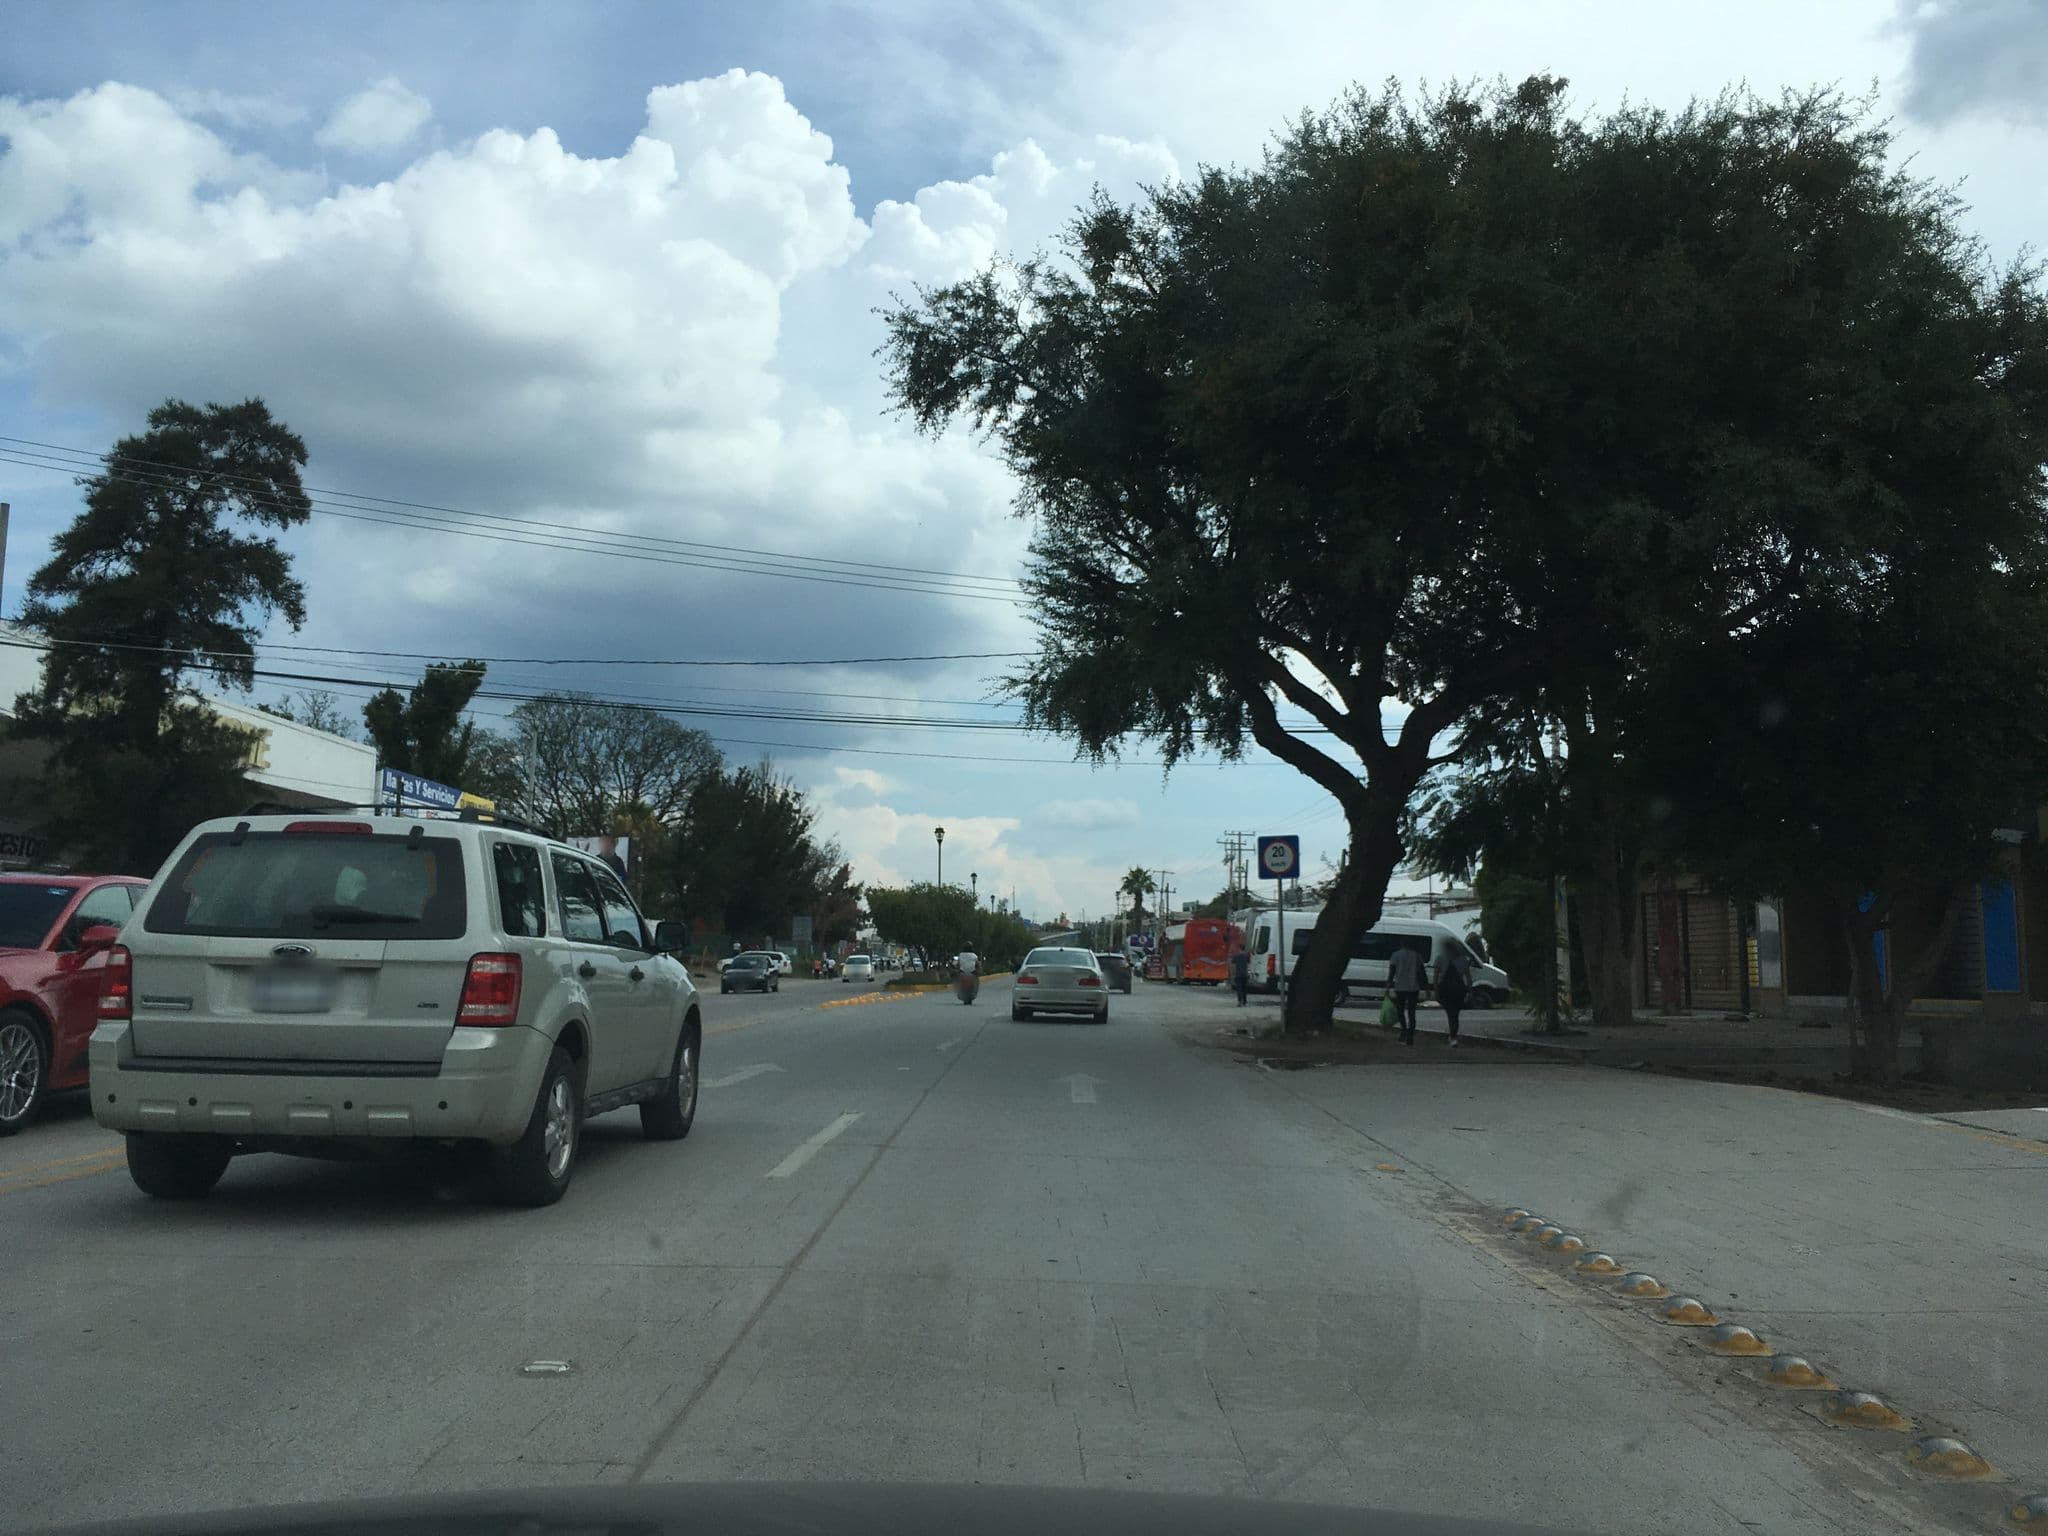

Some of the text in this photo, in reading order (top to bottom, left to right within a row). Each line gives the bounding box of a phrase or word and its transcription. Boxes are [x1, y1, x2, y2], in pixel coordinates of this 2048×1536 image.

[386, 771, 413, 793] llatas
[415, 779, 421, 795] Y
[422, 782, 455, 806] Servicios
[1271, 845, 1284, 857] 20
